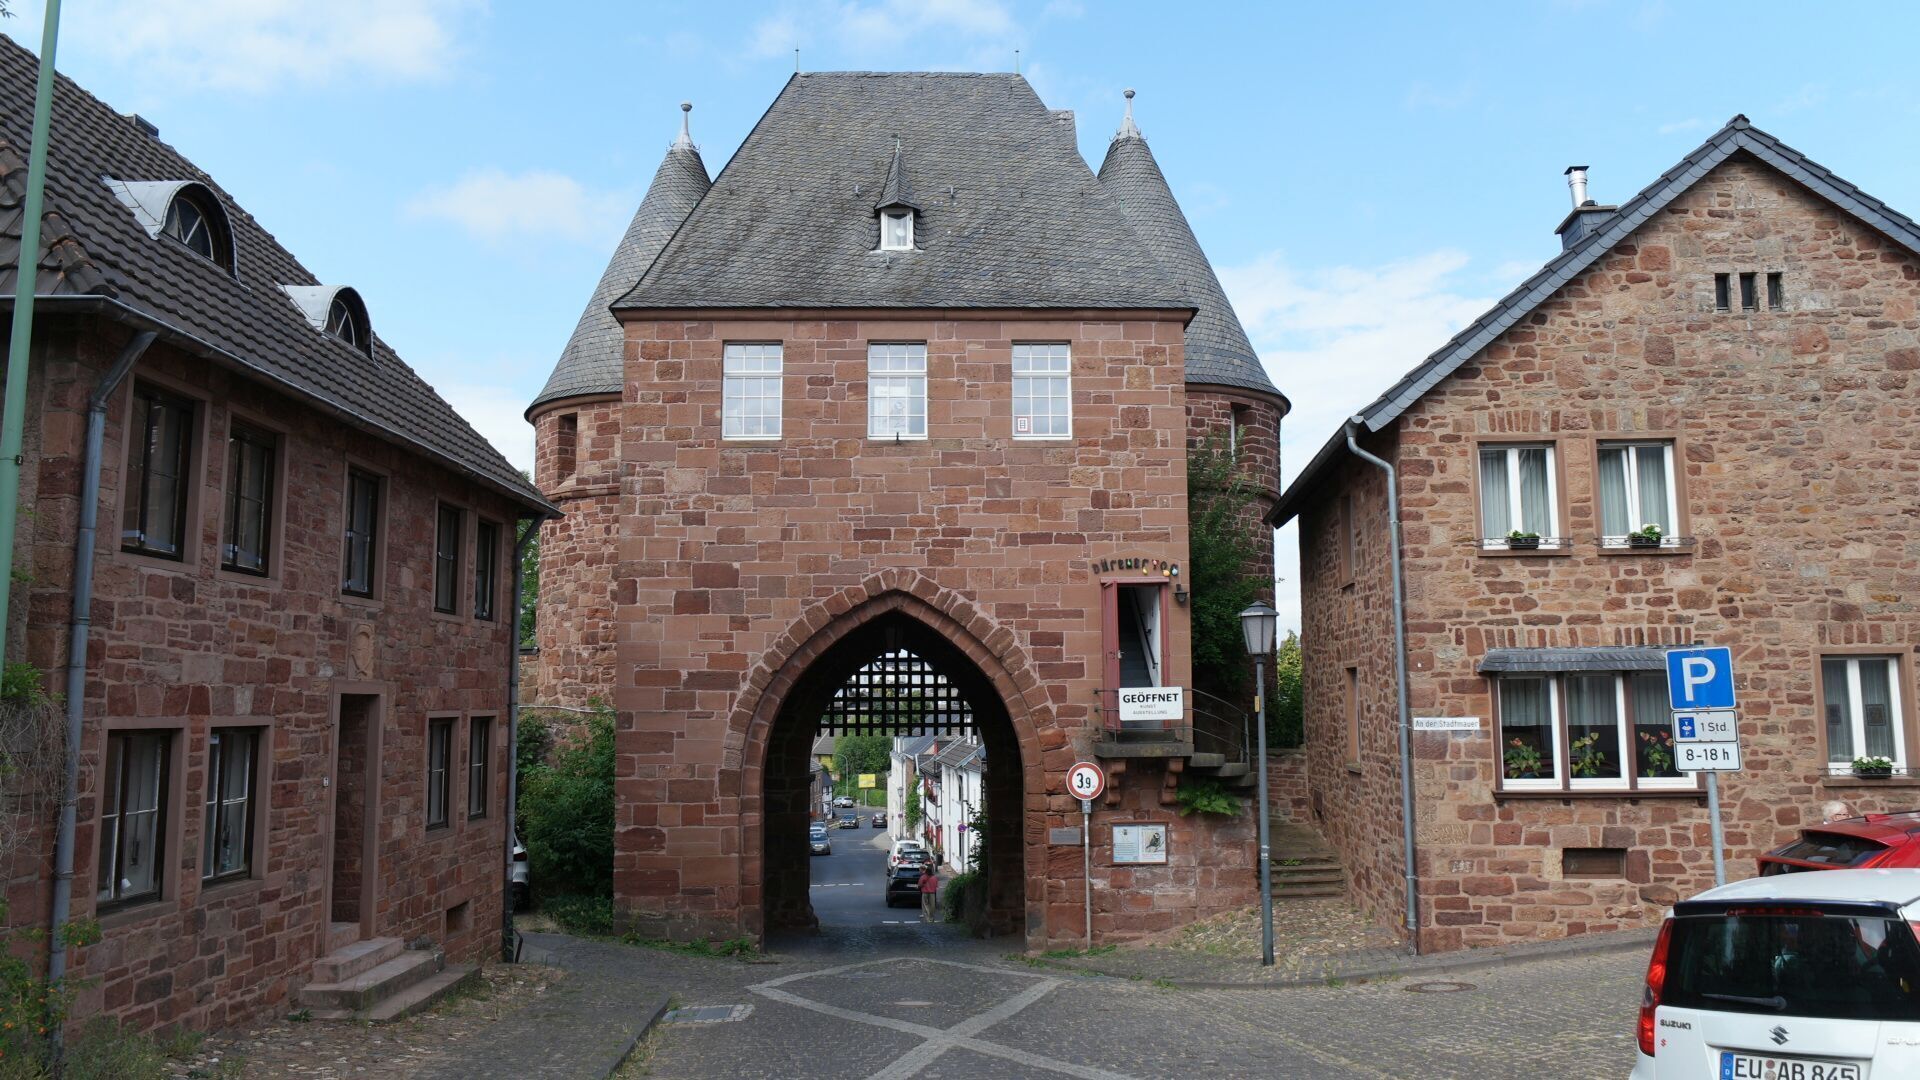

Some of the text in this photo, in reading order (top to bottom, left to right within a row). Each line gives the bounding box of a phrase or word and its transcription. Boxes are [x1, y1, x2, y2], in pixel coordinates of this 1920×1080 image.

[1681, 656, 1716, 701] P
[1122, 691, 1179, 703] GEÖFFNET
[1415, 720, 1479, 728] An der Stadtmauer
[1700, 722, 1705, 732] 1
[1686, 748, 1730, 761] 8-18 h
[1660, 1018, 1692, 1030] SUZUKI
[1735, 1057, 1855, 1080] EU AB 845
